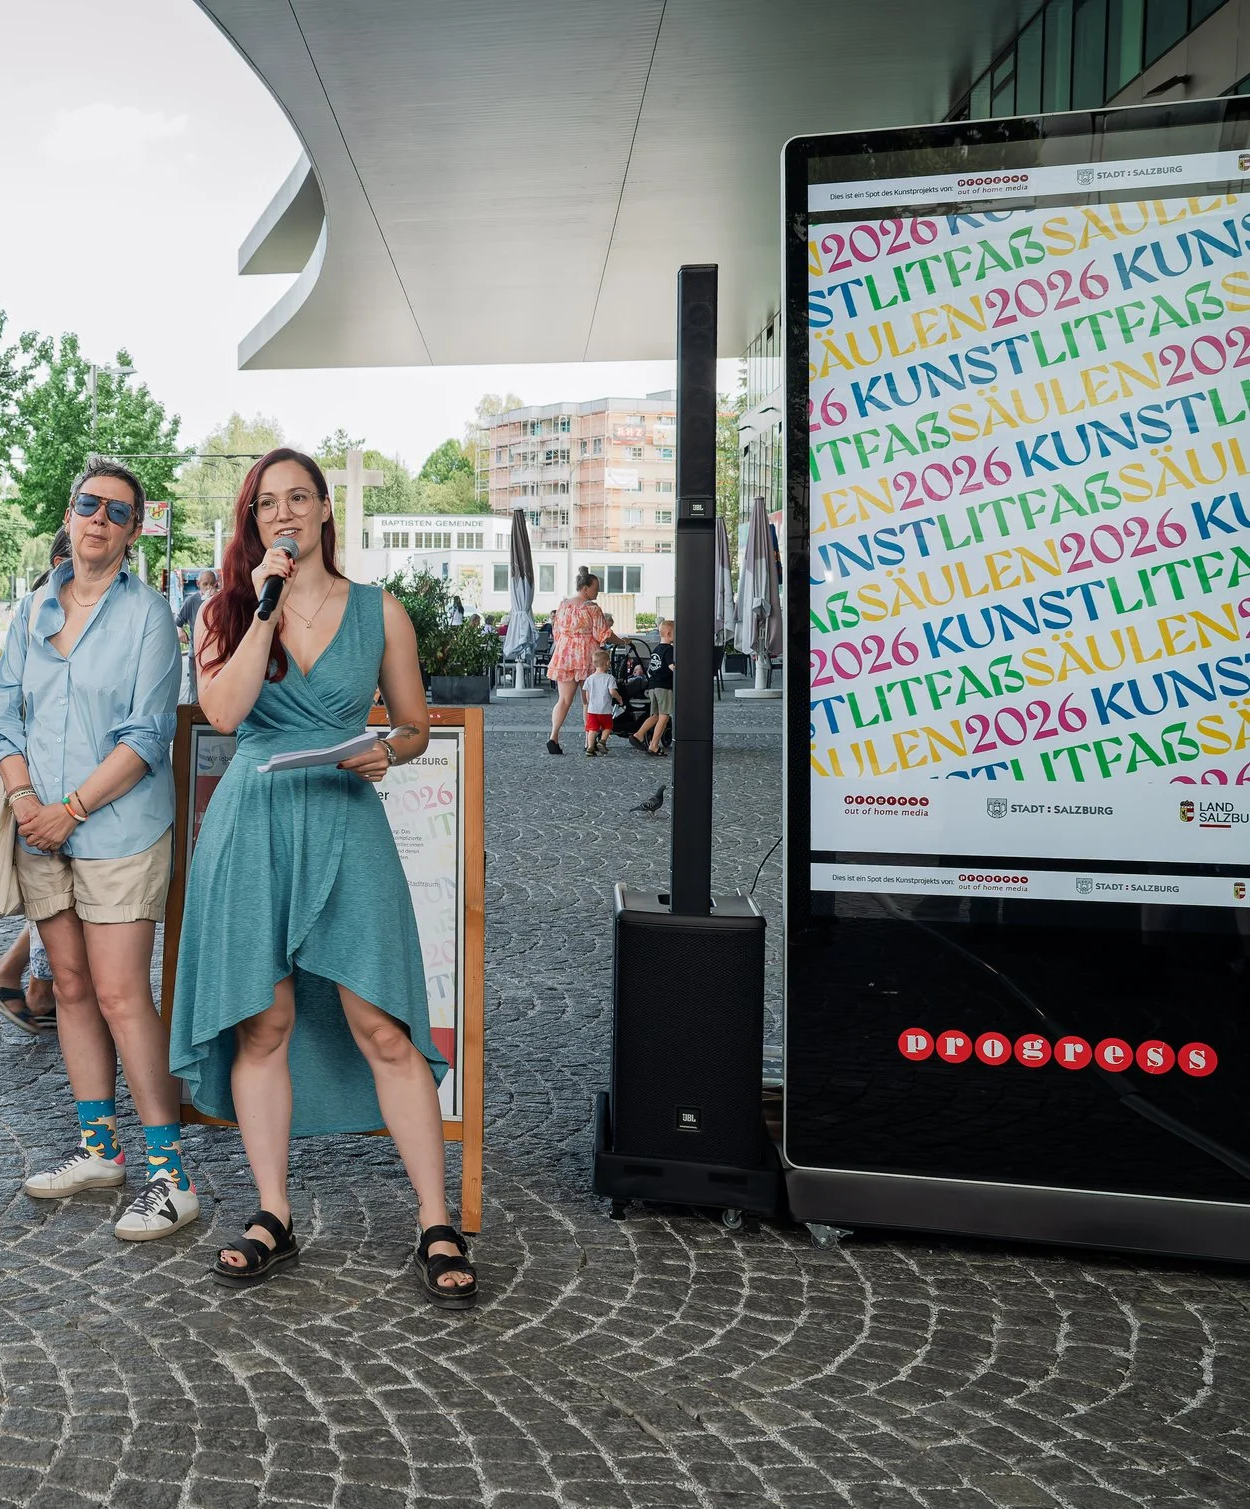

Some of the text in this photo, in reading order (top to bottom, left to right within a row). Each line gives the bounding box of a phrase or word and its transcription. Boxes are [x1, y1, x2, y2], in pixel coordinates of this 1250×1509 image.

[1096, 170, 1126, 180] STADT
[1133, 165, 1183, 177] SALZBURG
[830, 192, 843, 200] Dies
[845, 191, 853, 199] ist
[854, 190, 864, 198] ein
[865, 189, 880, 200] Spot
[881, 188, 893, 197] des
[894, 185, 939, 197] Kunstprojekts
[957, 188, 971, 196] out
[1005, 183, 1029, 192] media
[381, 519, 484, 527] BAPTISTEN GEMEINDE
[844, 807, 929, 817] out of home media
[1010, 804, 1045, 814] STADT
[1054, 805, 1114, 816] SALZBURG
[1199, 801, 1234, 812] LAND
[832, 874, 847, 882] Dies
[847, 874, 855, 882] ist
[867, 875, 882, 885] Spot
[883, 875, 895, 883] des
[895, 876, 940, 887] Kunstprojekts
[1095, 882, 1124, 891] STADT
[1130, 883, 1180, 893] SALZBURG
[898, 1028, 1218, 1077] progress
